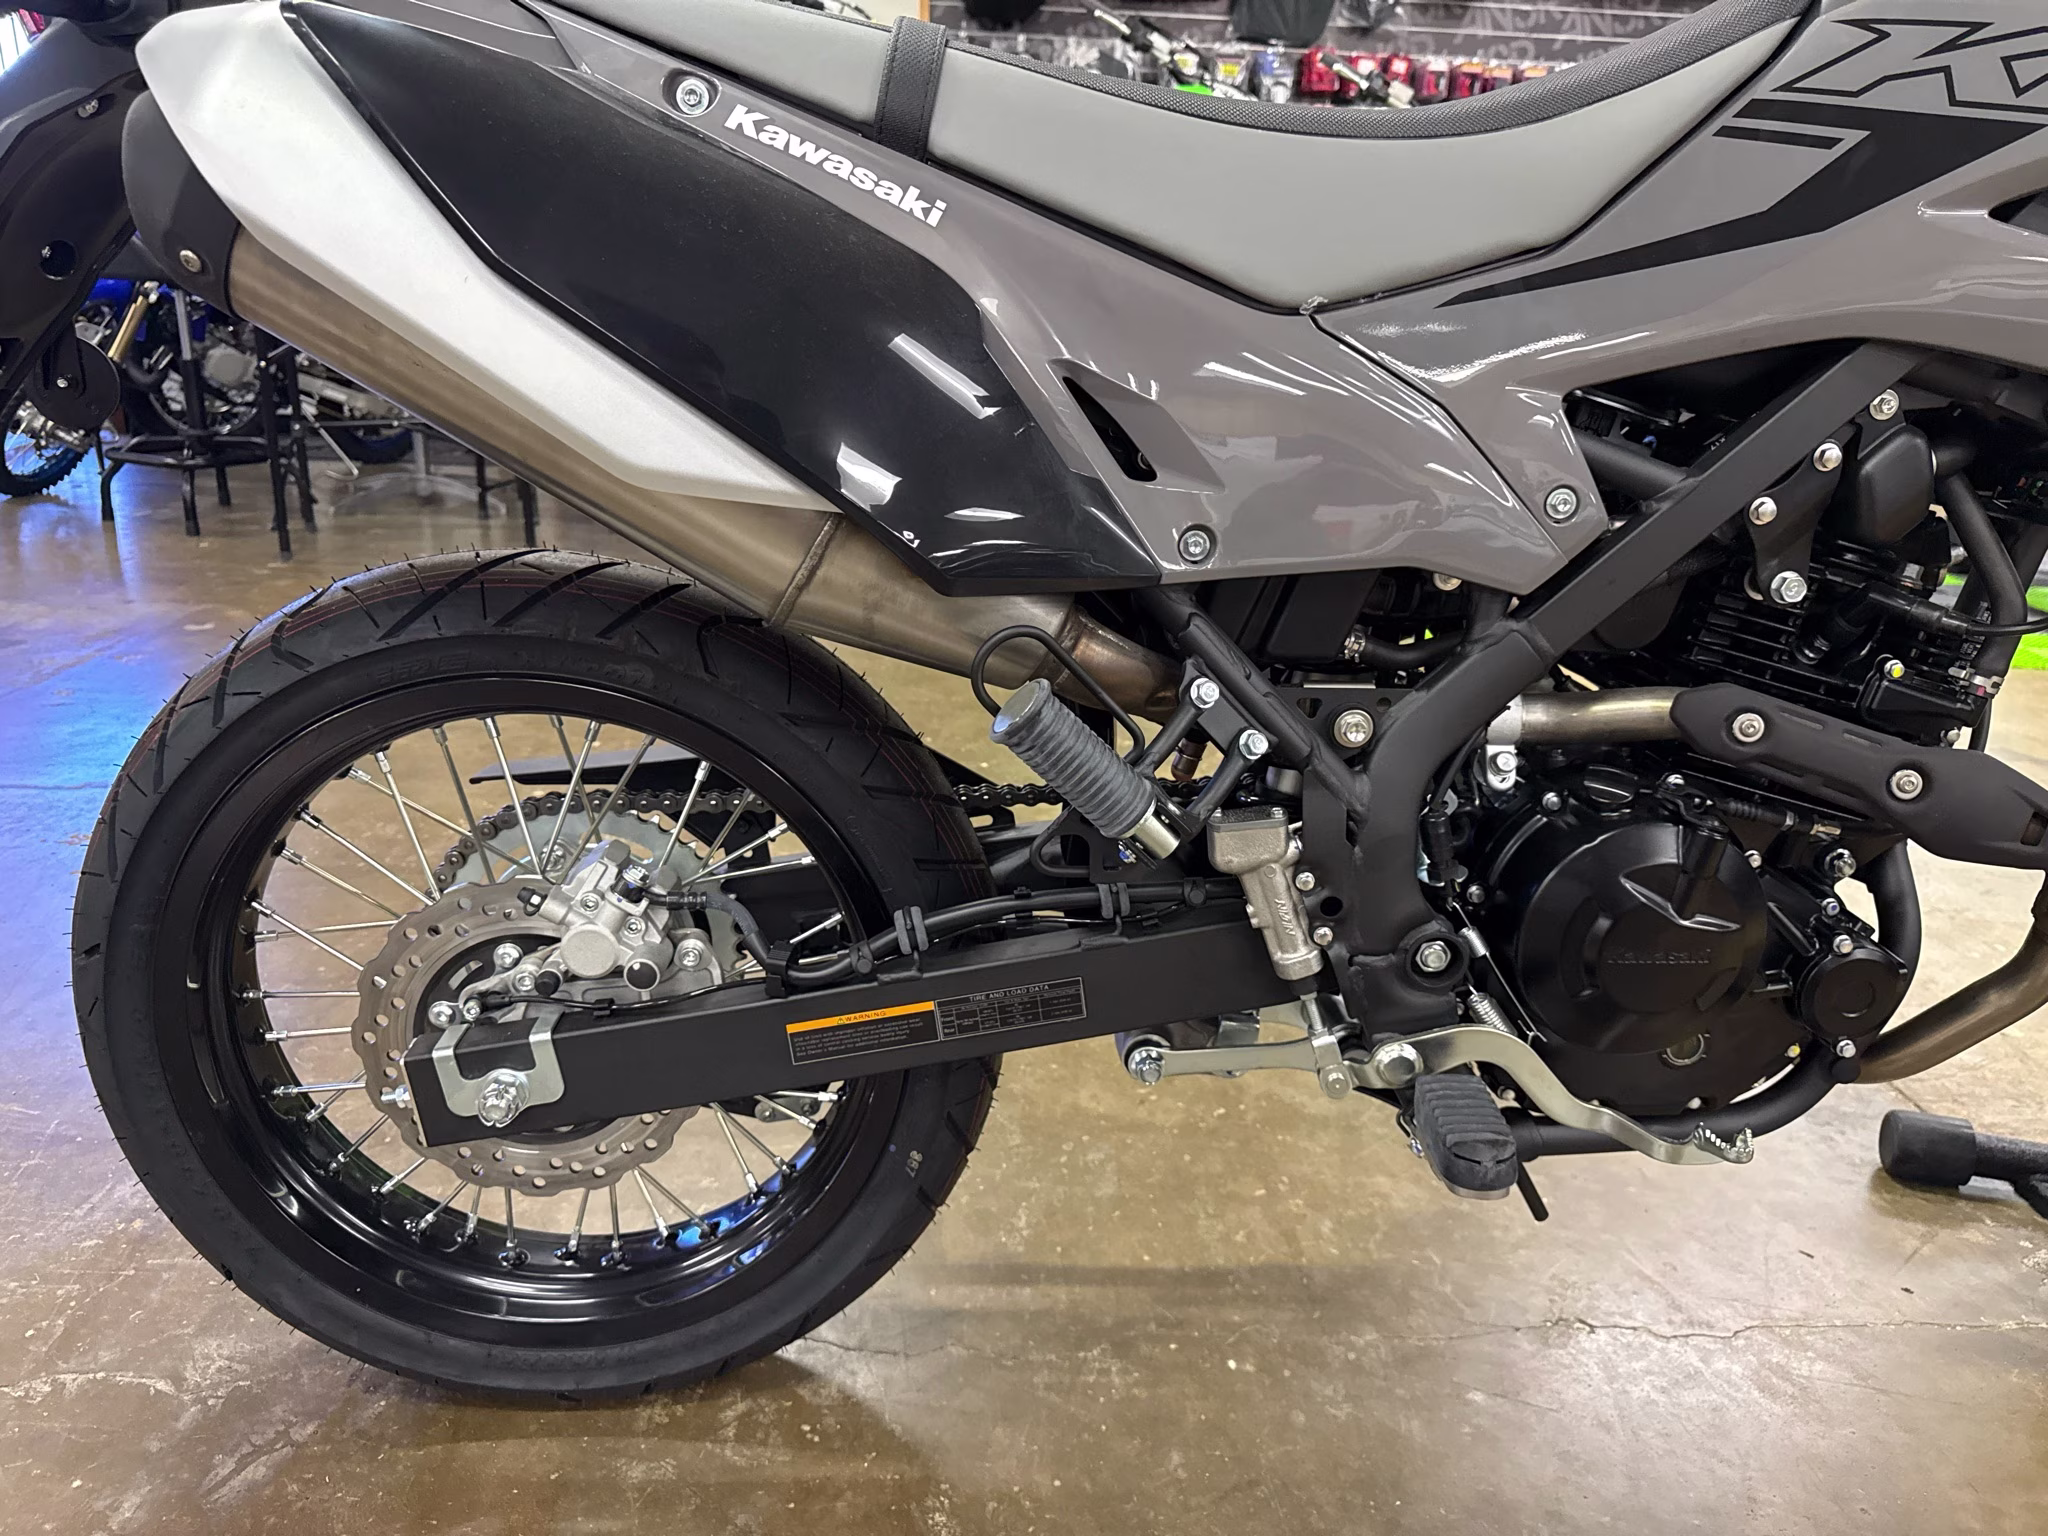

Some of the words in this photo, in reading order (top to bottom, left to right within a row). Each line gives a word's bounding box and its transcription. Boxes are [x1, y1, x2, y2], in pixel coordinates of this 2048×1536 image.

[724, 103, 947, 228] Kawasaki
[969, 994, 986, 1002] TIRE
[989, 991, 1005, 1000] AND
[1006, 988, 1027, 997] LOAD
[1030, 984, 1049, 993] DATA
[845, 1011, 887, 1022] WARNING
